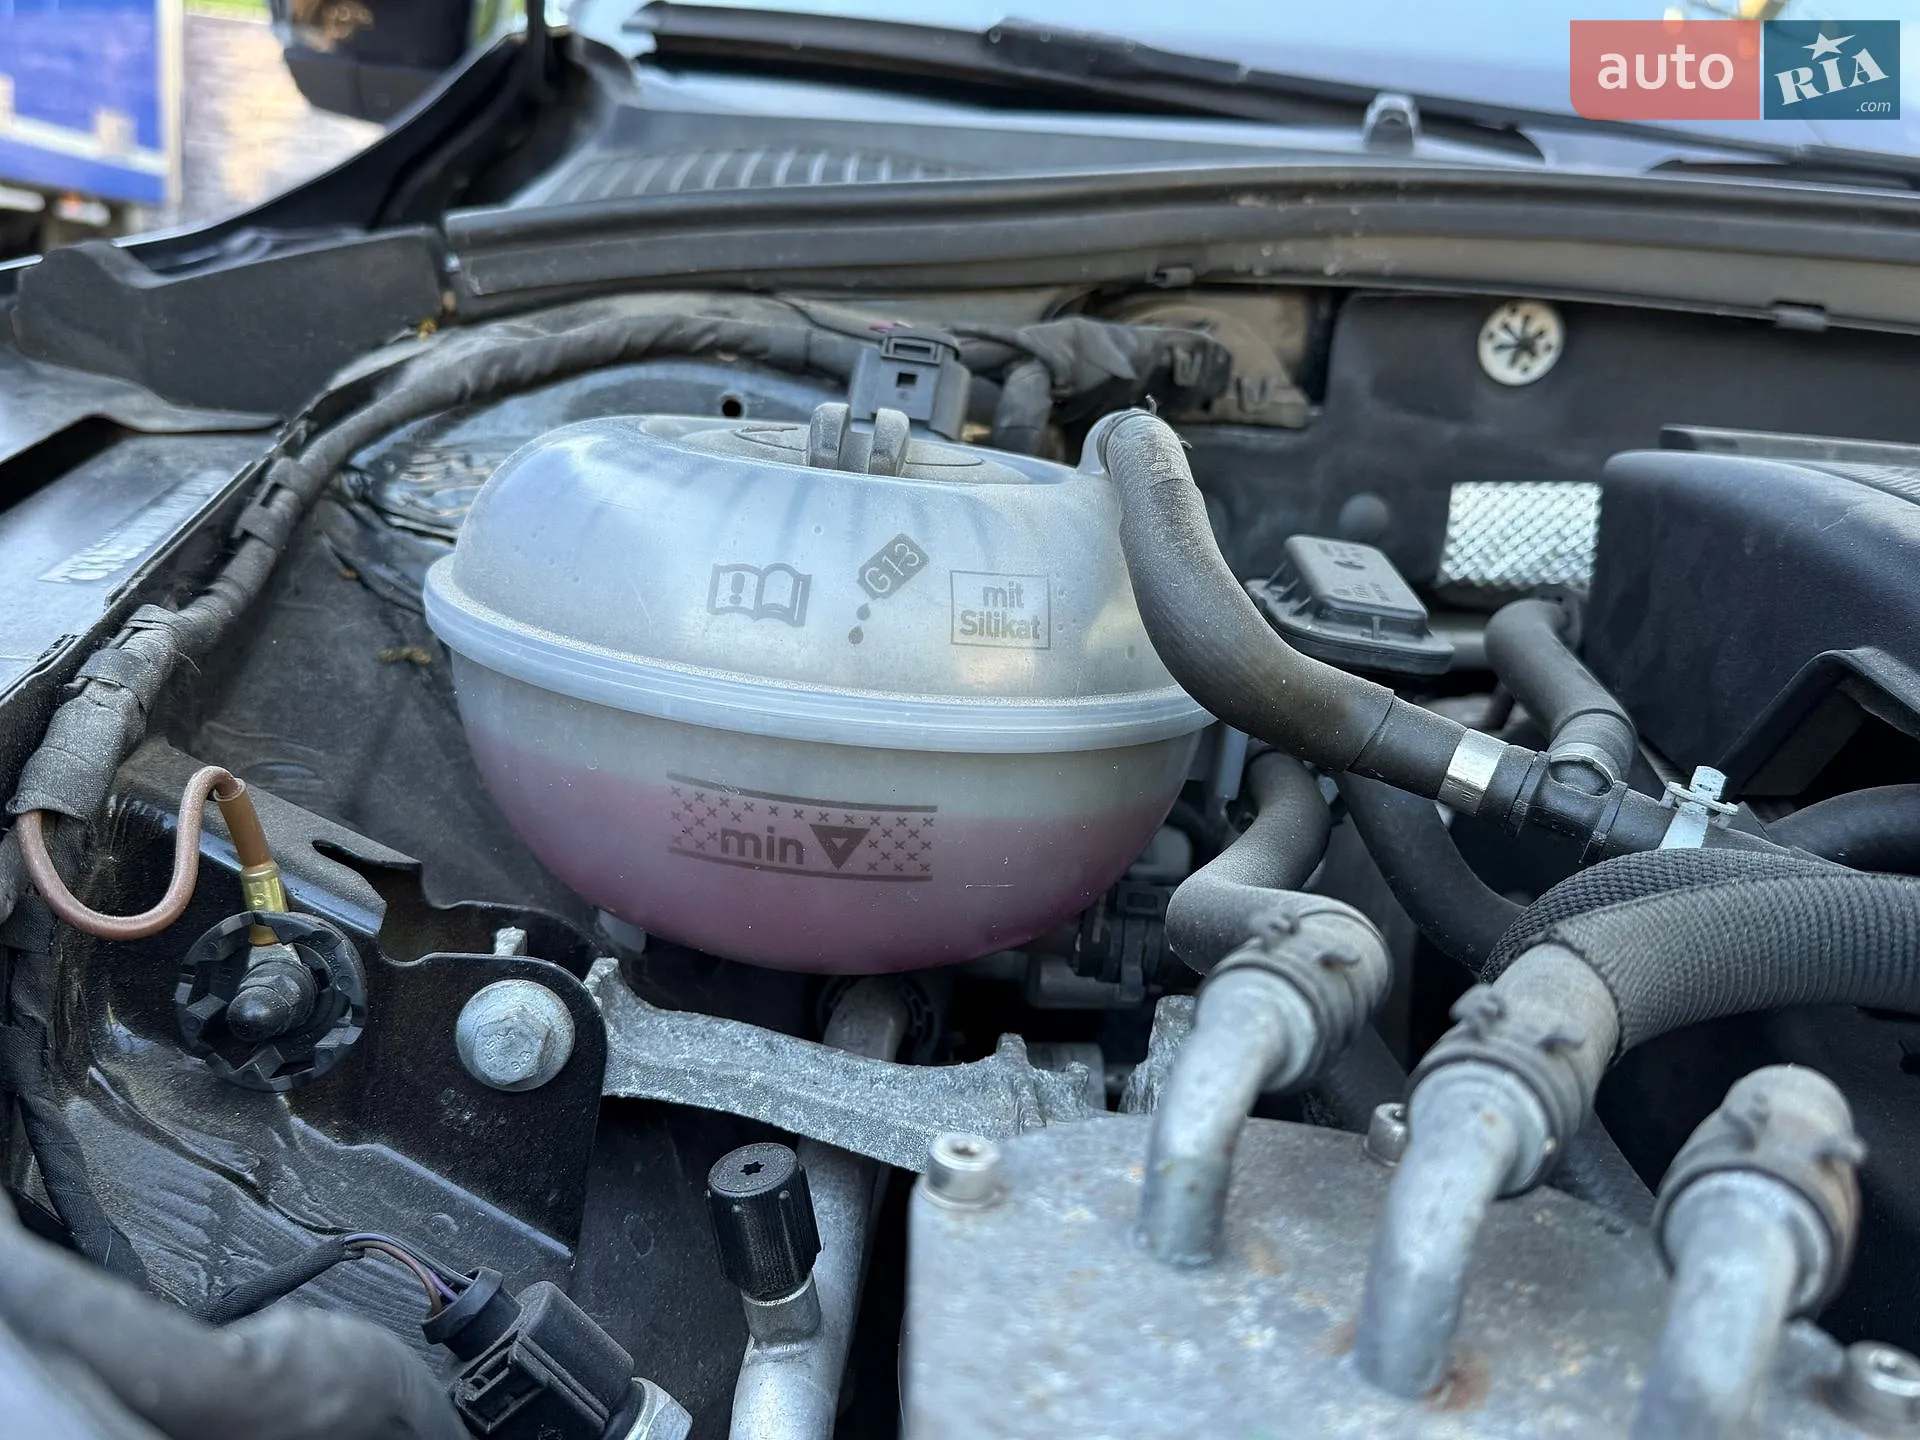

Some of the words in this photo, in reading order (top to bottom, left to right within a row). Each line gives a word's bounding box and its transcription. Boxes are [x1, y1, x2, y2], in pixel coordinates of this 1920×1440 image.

[864, 543, 920, 594] G13
[982, 581, 1025, 609] mit
[959, 609, 1041, 640] Silikat
[721, 826, 804, 865] min
